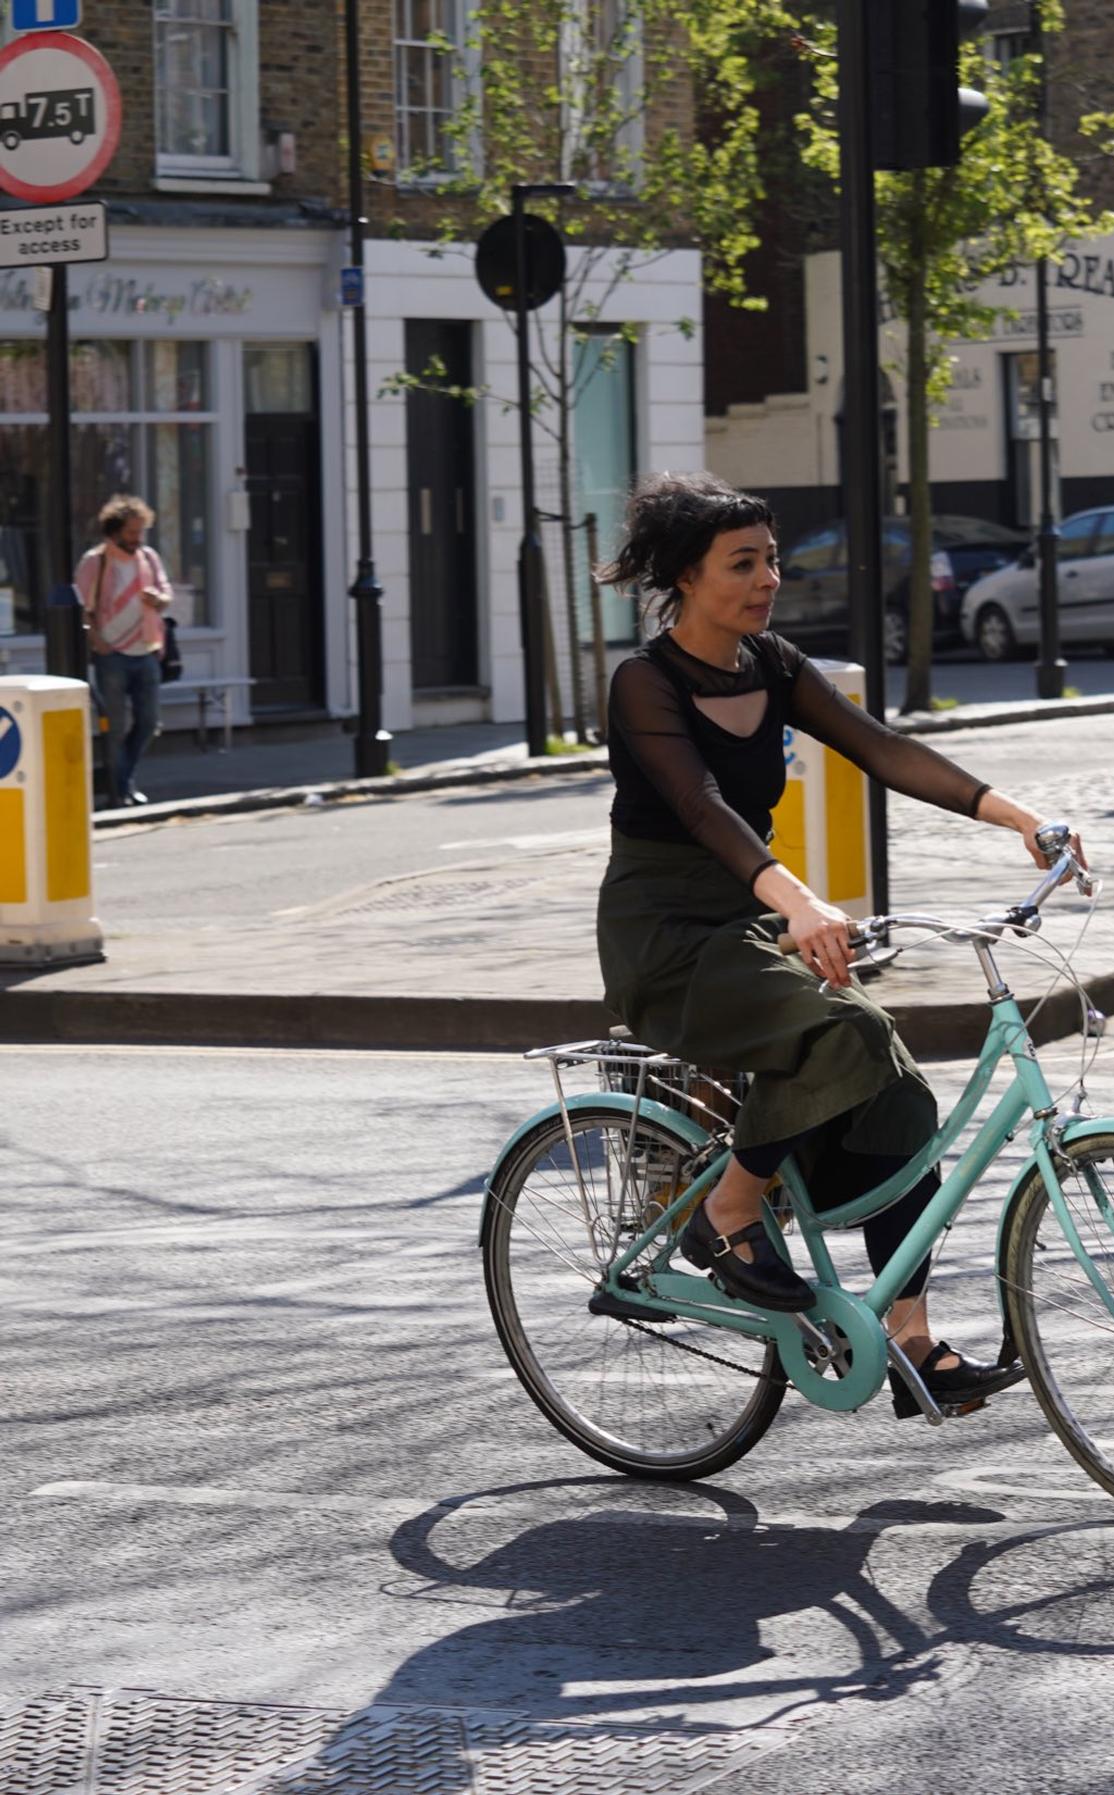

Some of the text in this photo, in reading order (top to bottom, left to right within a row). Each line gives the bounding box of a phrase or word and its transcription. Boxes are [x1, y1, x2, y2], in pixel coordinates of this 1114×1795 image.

[1, 213, 97, 235] Except for
[18, 239, 81, 255] access
